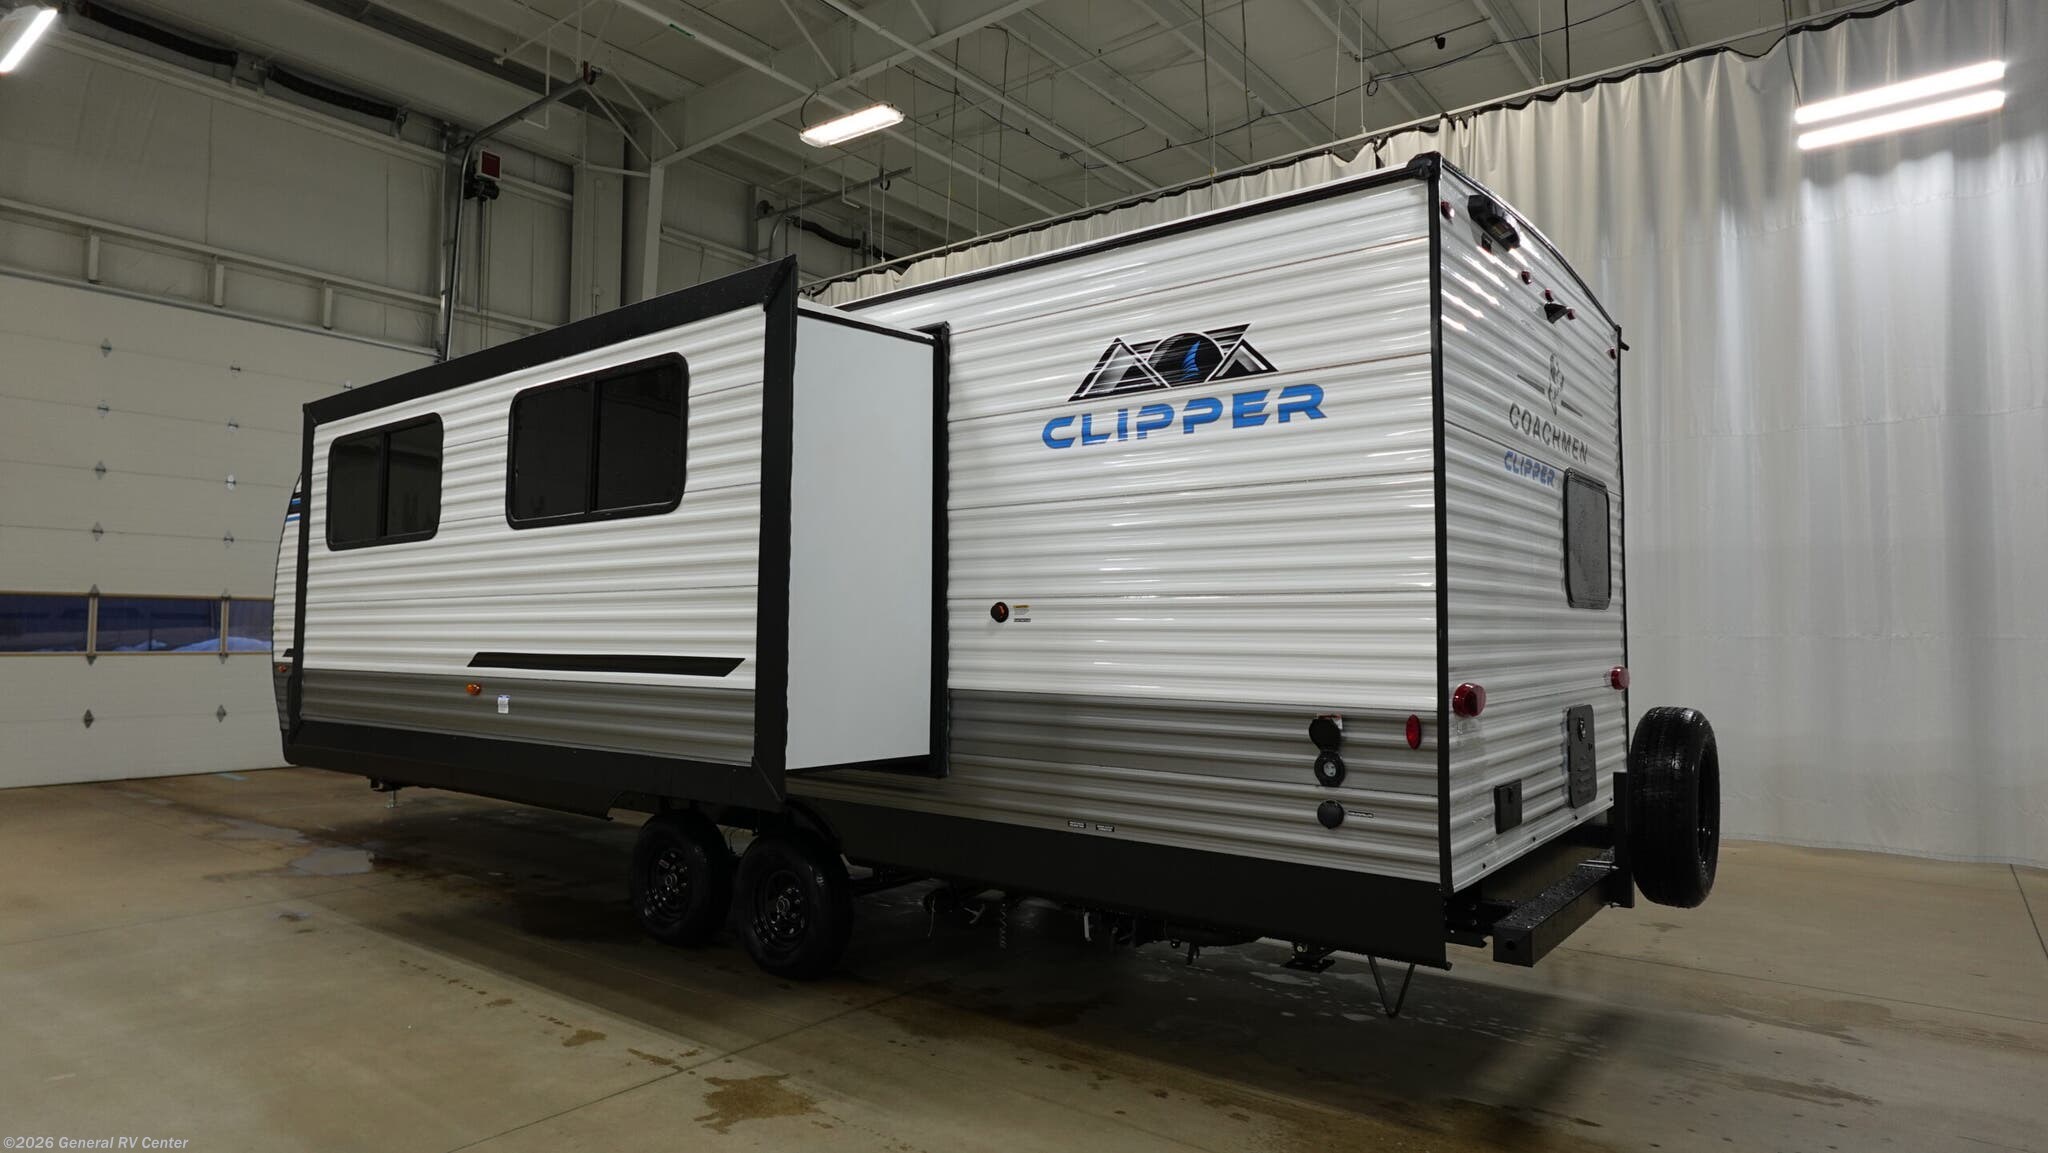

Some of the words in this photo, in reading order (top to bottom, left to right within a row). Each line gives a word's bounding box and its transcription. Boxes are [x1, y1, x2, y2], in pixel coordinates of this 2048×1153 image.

[1042, 383, 1327, 449] CLIPPER
[1509, 403, 1588, 464] COACHMEN
[1504, 451, 1556, 488] CLIPPER
